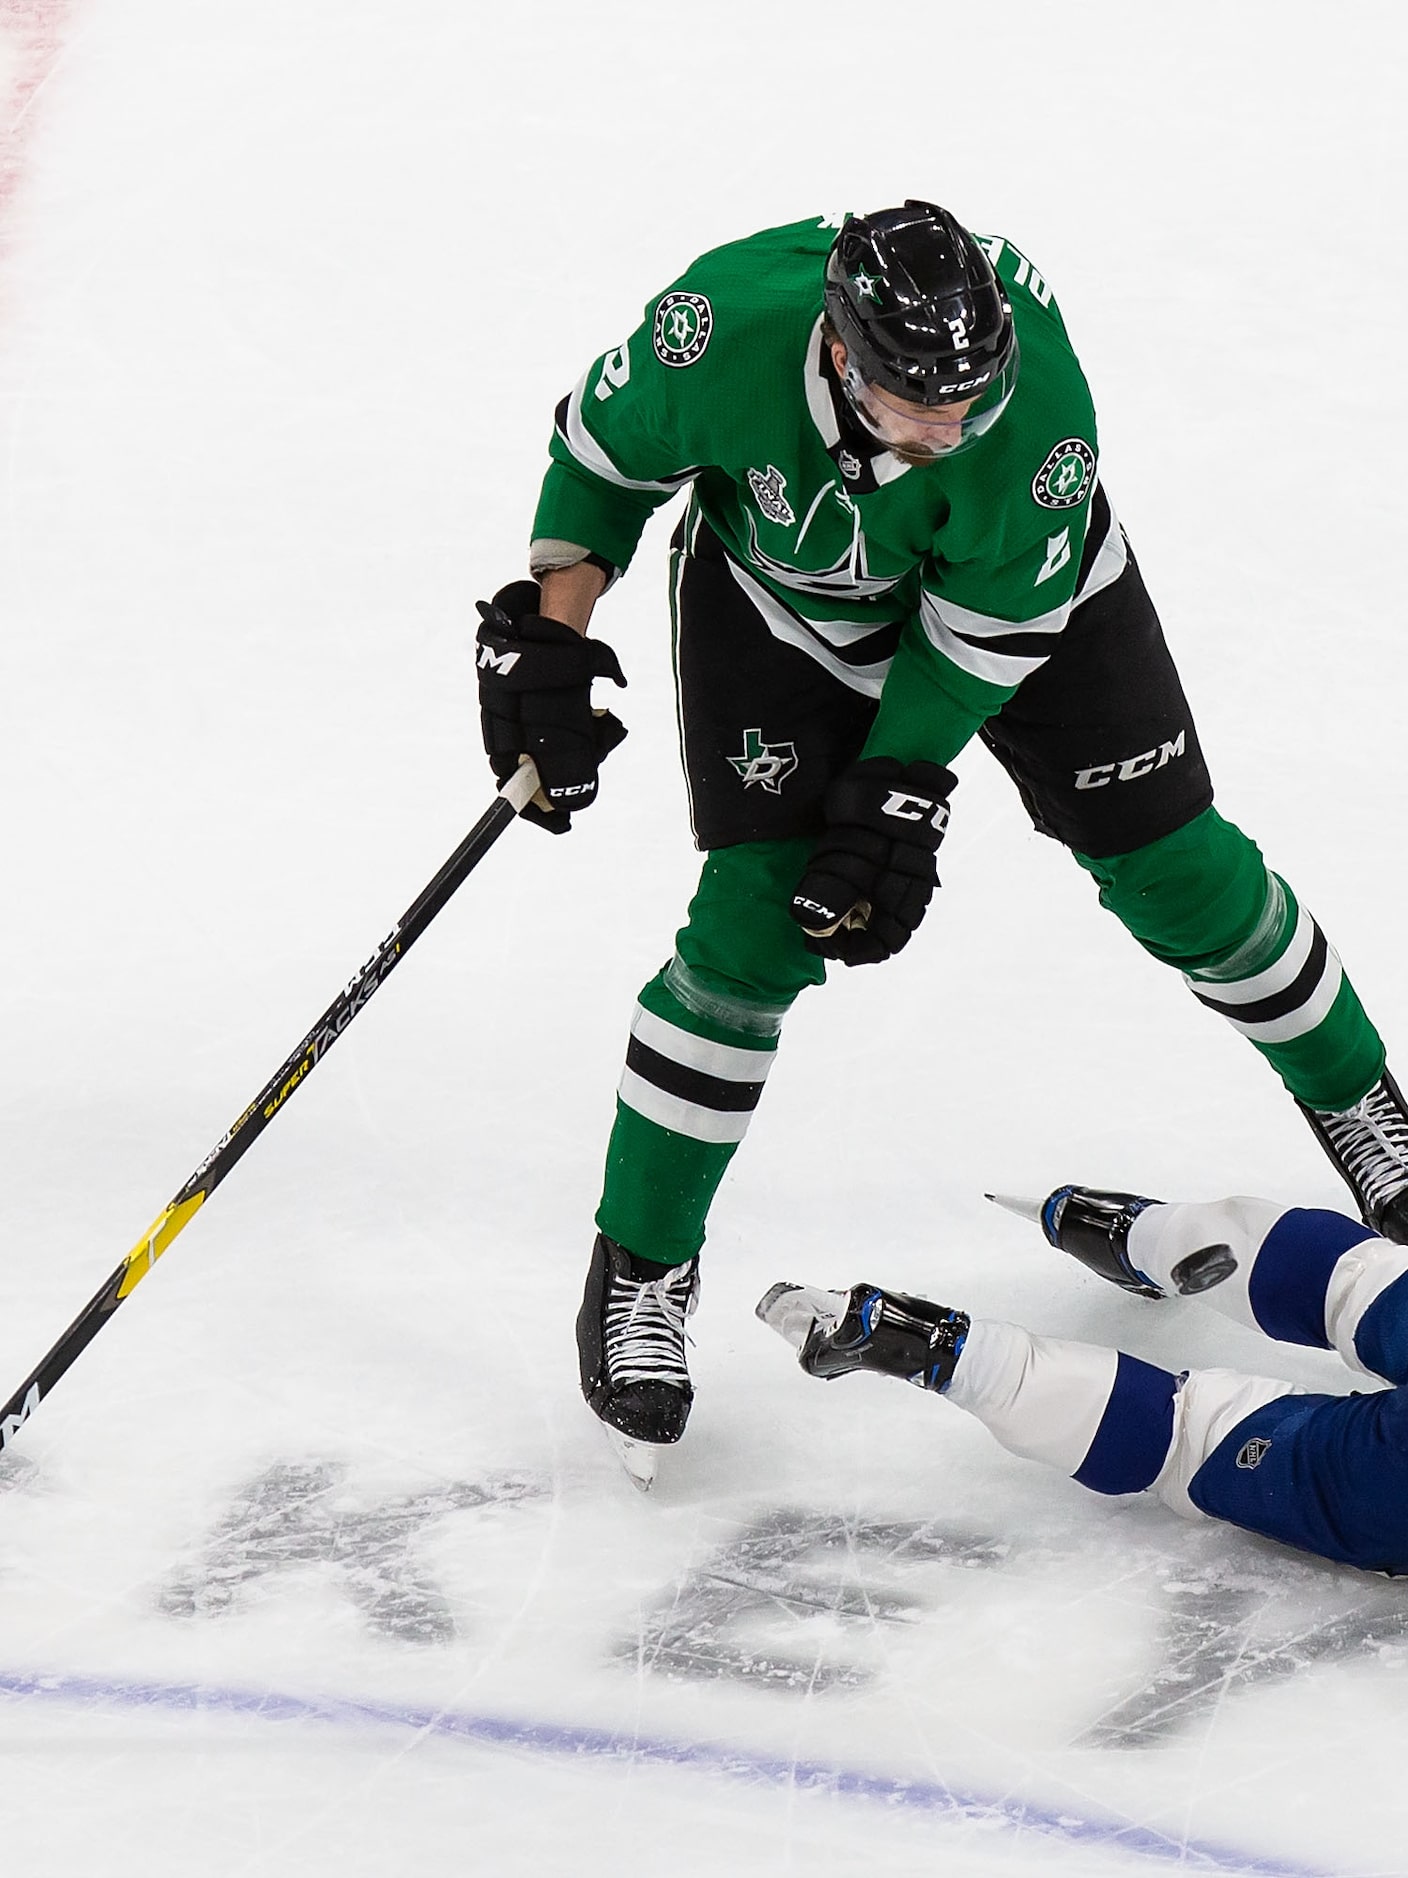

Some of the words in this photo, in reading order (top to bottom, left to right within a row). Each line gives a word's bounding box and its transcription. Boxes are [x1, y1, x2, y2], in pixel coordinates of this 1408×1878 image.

[948, 317, 970, 350] 2
[938, 371, 991, 394] CCM
[1036, 443, 1082, 495] DALLAS
[1074, 729, 1185, 790] CCM
[549, 780, 596, 798] CCM
[793, 895, 837, 920] CCM
[263, 1058, 310, 1119] SUPER
[306, 970, 380, 1064] TACKS
